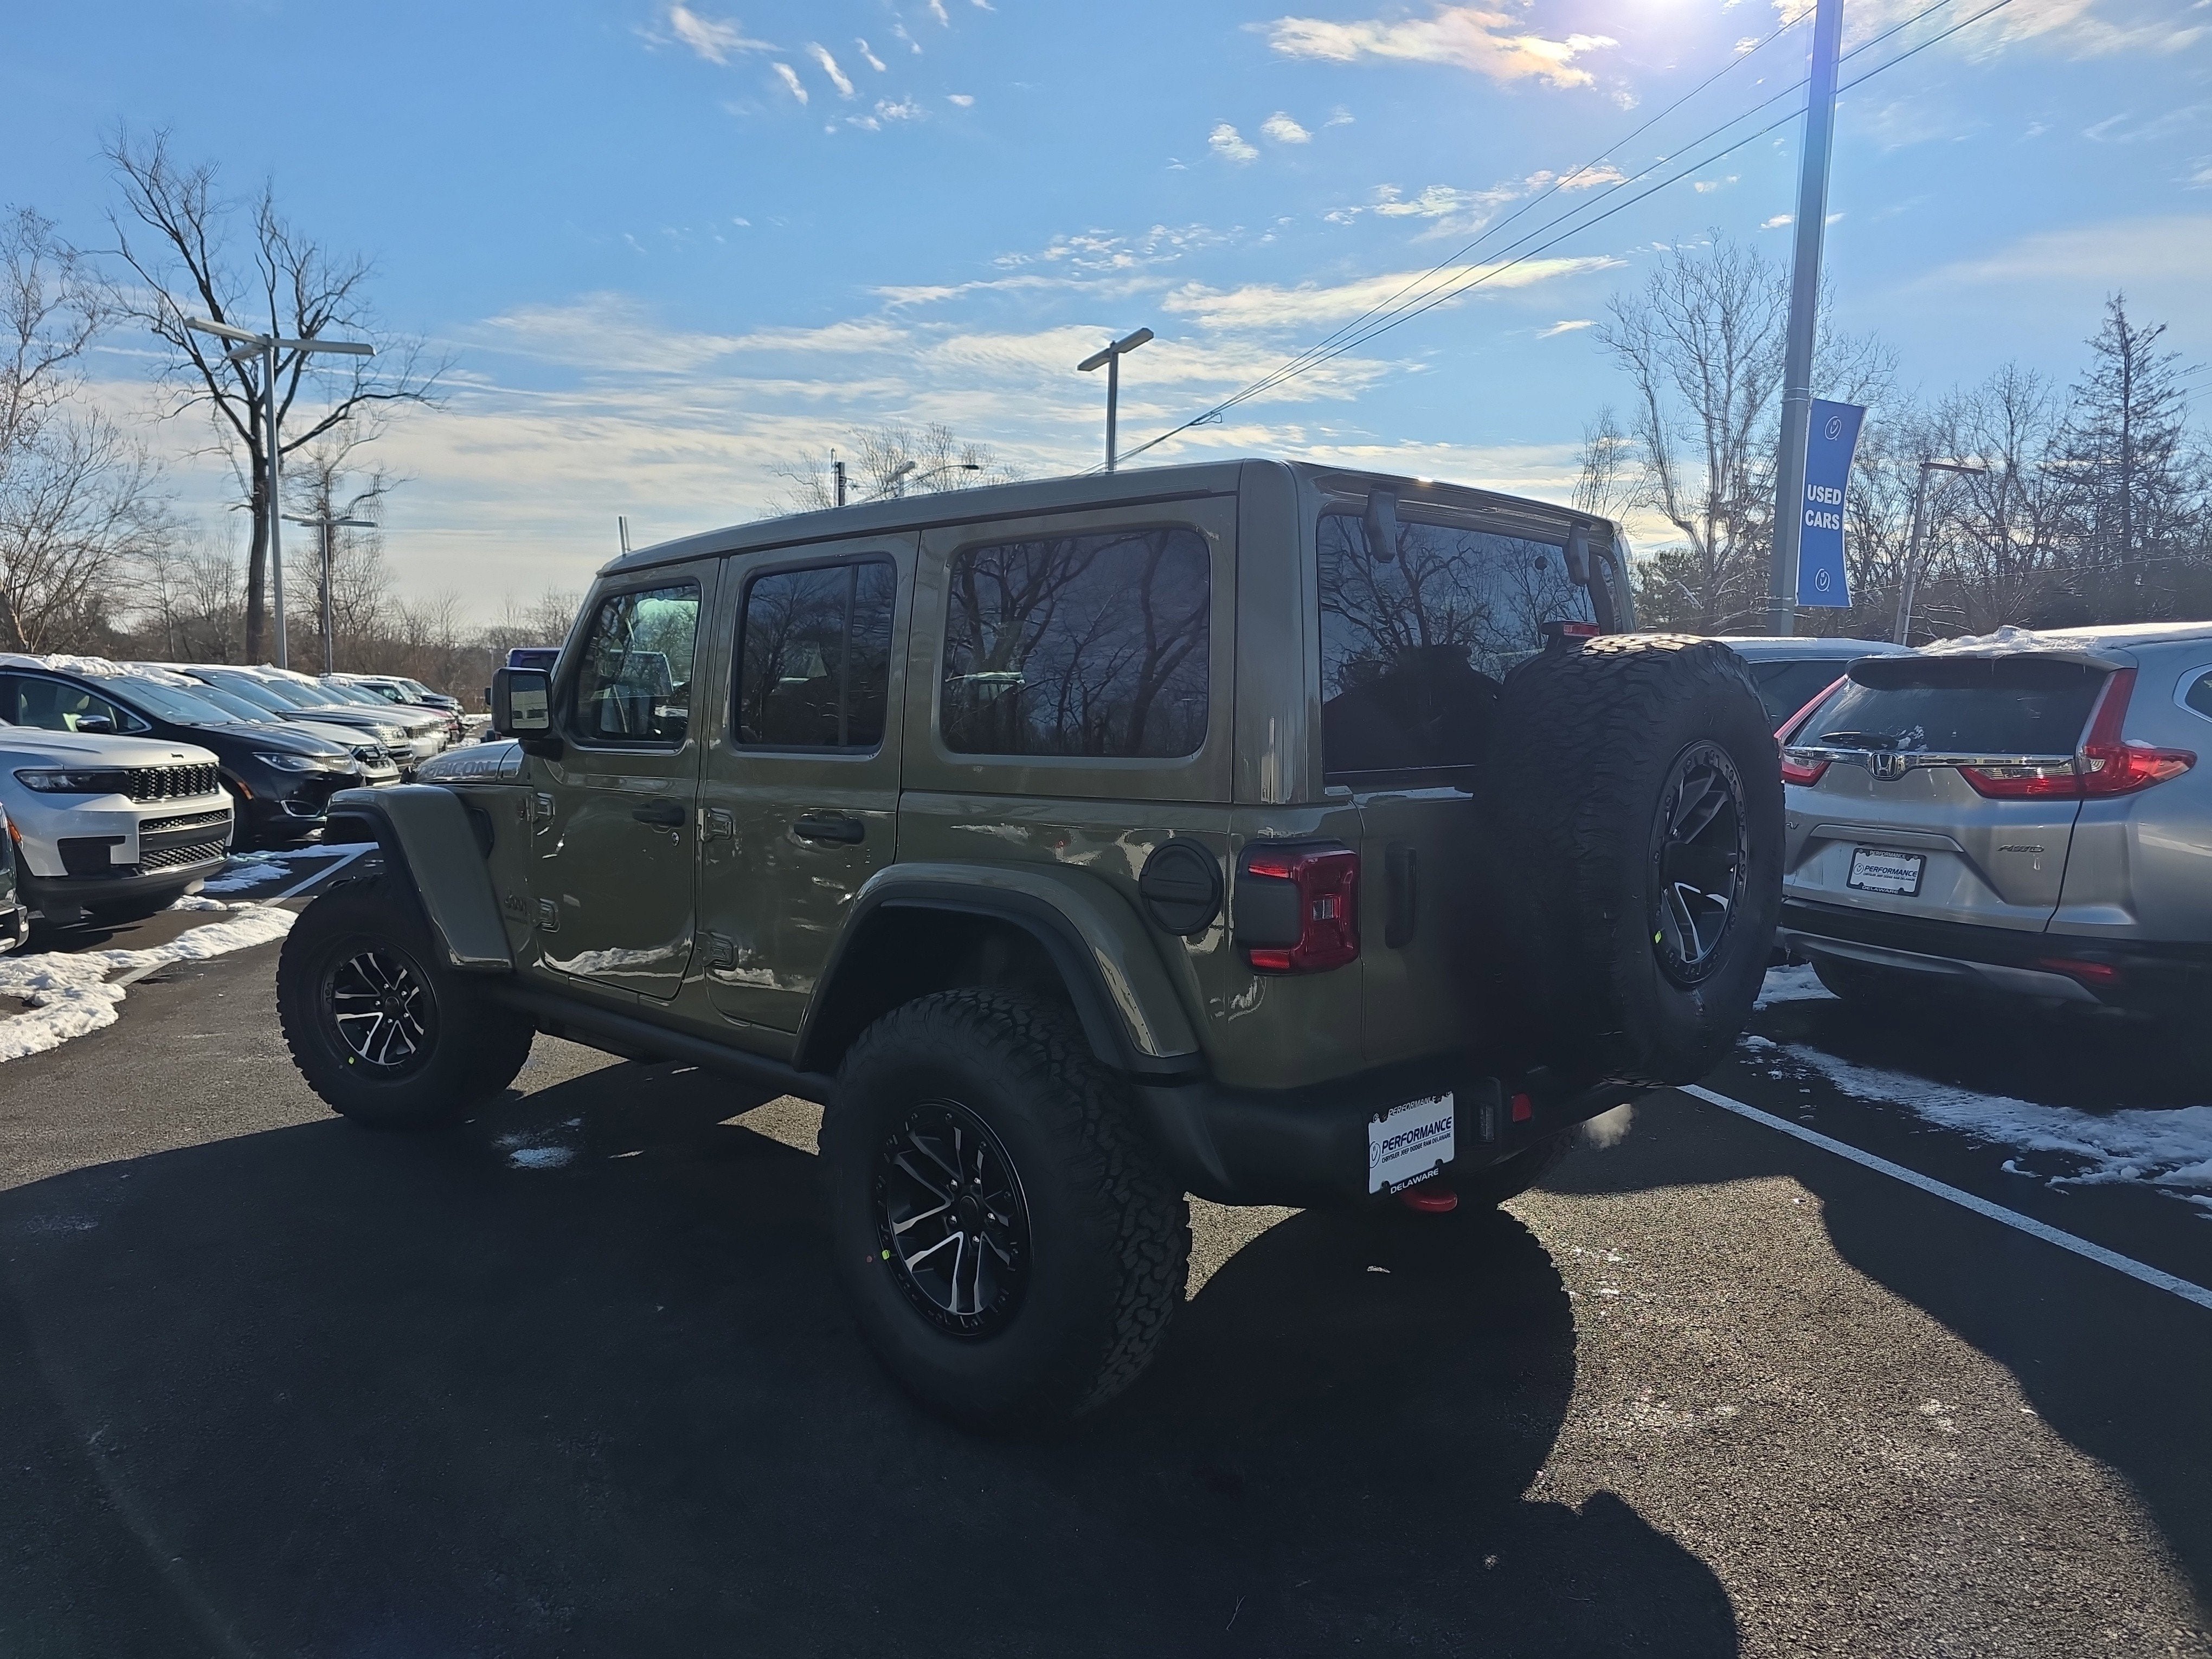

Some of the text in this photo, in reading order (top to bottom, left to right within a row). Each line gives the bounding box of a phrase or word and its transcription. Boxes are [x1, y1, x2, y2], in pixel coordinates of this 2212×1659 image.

[1807, 484, 1842, 505] USED
[1805, 509, 1840, 530] CARS
[1869, 850, 1906, 859] PERFORMANCE
[1996, 844, 2044, 853] AWD
[1864, 865, 1918, 877] PERFORMANCE
[1862, 885, 1898, 894] DELAWARE
[1388, 1095, 1437, 1116] PERFORMANCE
[1381, 1116, 1452, 1154] PERFORMANCE
[1381, 1151, 1400, 1163] CHRYSLER
[1400, 1148, 1410, 1156] JEEP
[1410, 1143, 1423, 1153] DODGE
[1432, 1132, 1451, 1144] DELAWARE
[1390, 1167, 1439, 1194] DELAWARE
